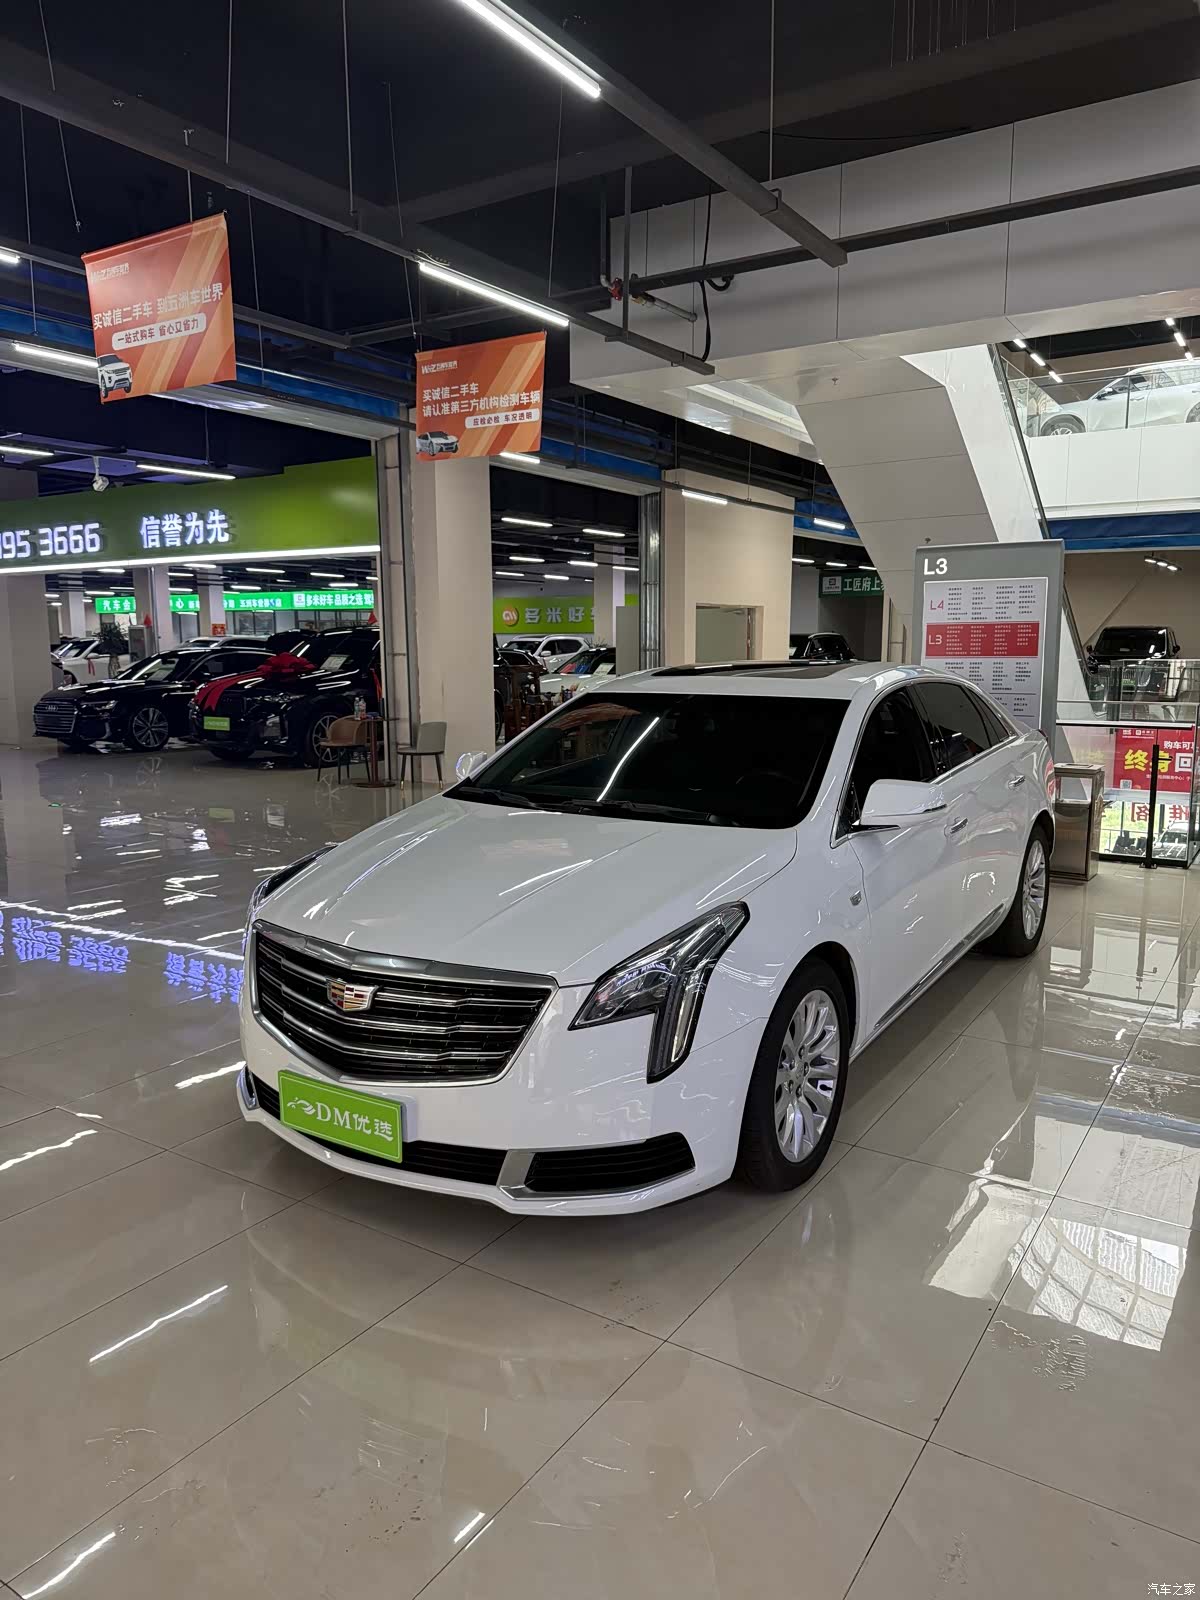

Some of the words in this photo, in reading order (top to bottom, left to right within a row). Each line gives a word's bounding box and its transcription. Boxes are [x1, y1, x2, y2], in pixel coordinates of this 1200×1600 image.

[93, 301, 153, 330] 买诚信二手车
[157, 282, 223, 314] 到五洲车世界
[117, 328, 156, 344] 一站式购车
[158, 318, 199, 336] 省心又省力
[422, 382, 479, 402] 买诚信二手车
[422, 390, 541, 417] 请认准第三方机构检测车辆
[473, 415, 500, 426] 应检必检
[504, 411, 533, 422] 车况透明
[0, 529, 31, 559] 95
[38, 523, 100, 556] 3666
[140, 509, 229, 549] 信誉为先
[923, 557, 948, 575] L3
[102, 599, 136, 611] 汽车金
[930, 599, 944, 611] L4
[525, 606, 596, 624] 多米好
[928, 634, 943, 645] L3
[315, 1101, 394, 1142] DM优选
